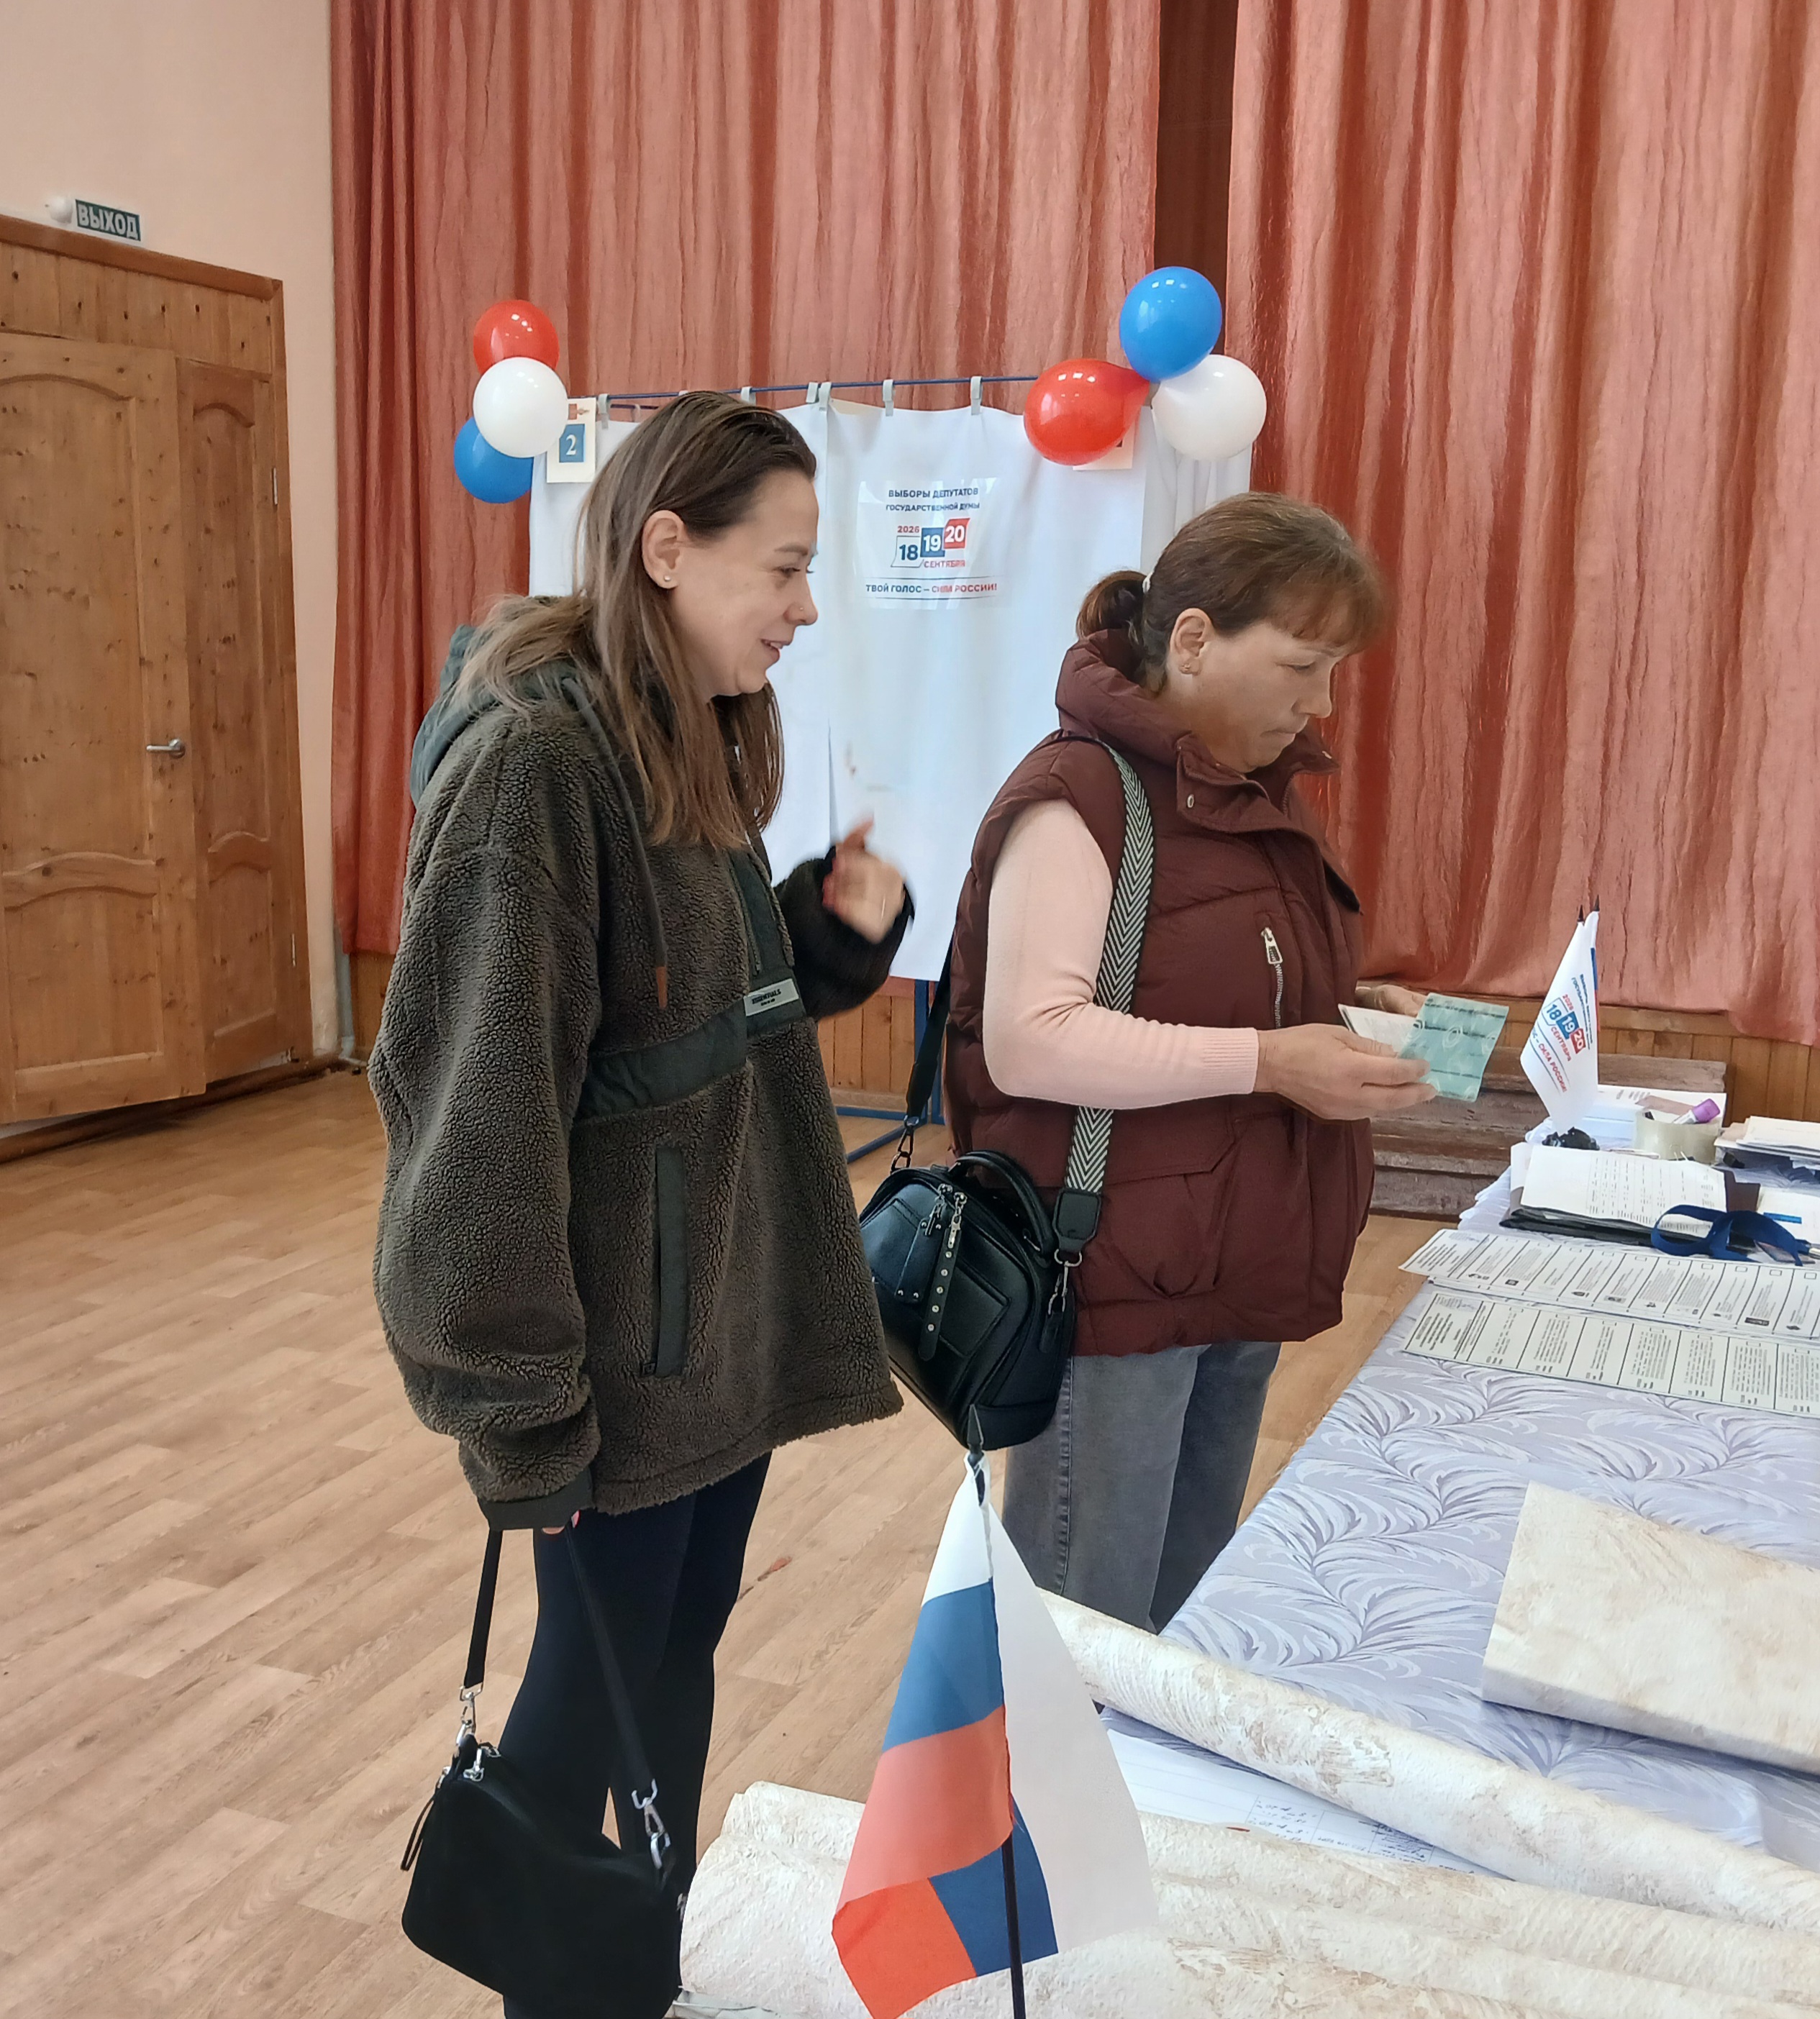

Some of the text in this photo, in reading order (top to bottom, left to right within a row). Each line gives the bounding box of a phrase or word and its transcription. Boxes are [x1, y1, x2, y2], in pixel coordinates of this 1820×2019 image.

[78, 204, 138, 240] ВЫХОД
[565, 434, 576, 456] 2
[932, 488, 978, 498] ДЕПУТАТОВ
[886, 503, 958, 511] ГОСУДАРСТВЕННОЙ
[899, 525, 965, 560] 18 19 20
[924, 560, 965, 568] СЕНТЯБРЯ
[866, 583, 889, 593] ТВОЙ
[891, 584, 922, 593] ГОЛОС
[955, 583, 997, 592] РОССИИ!
[1547, 1004, 1583, 1049] 18 19 20
